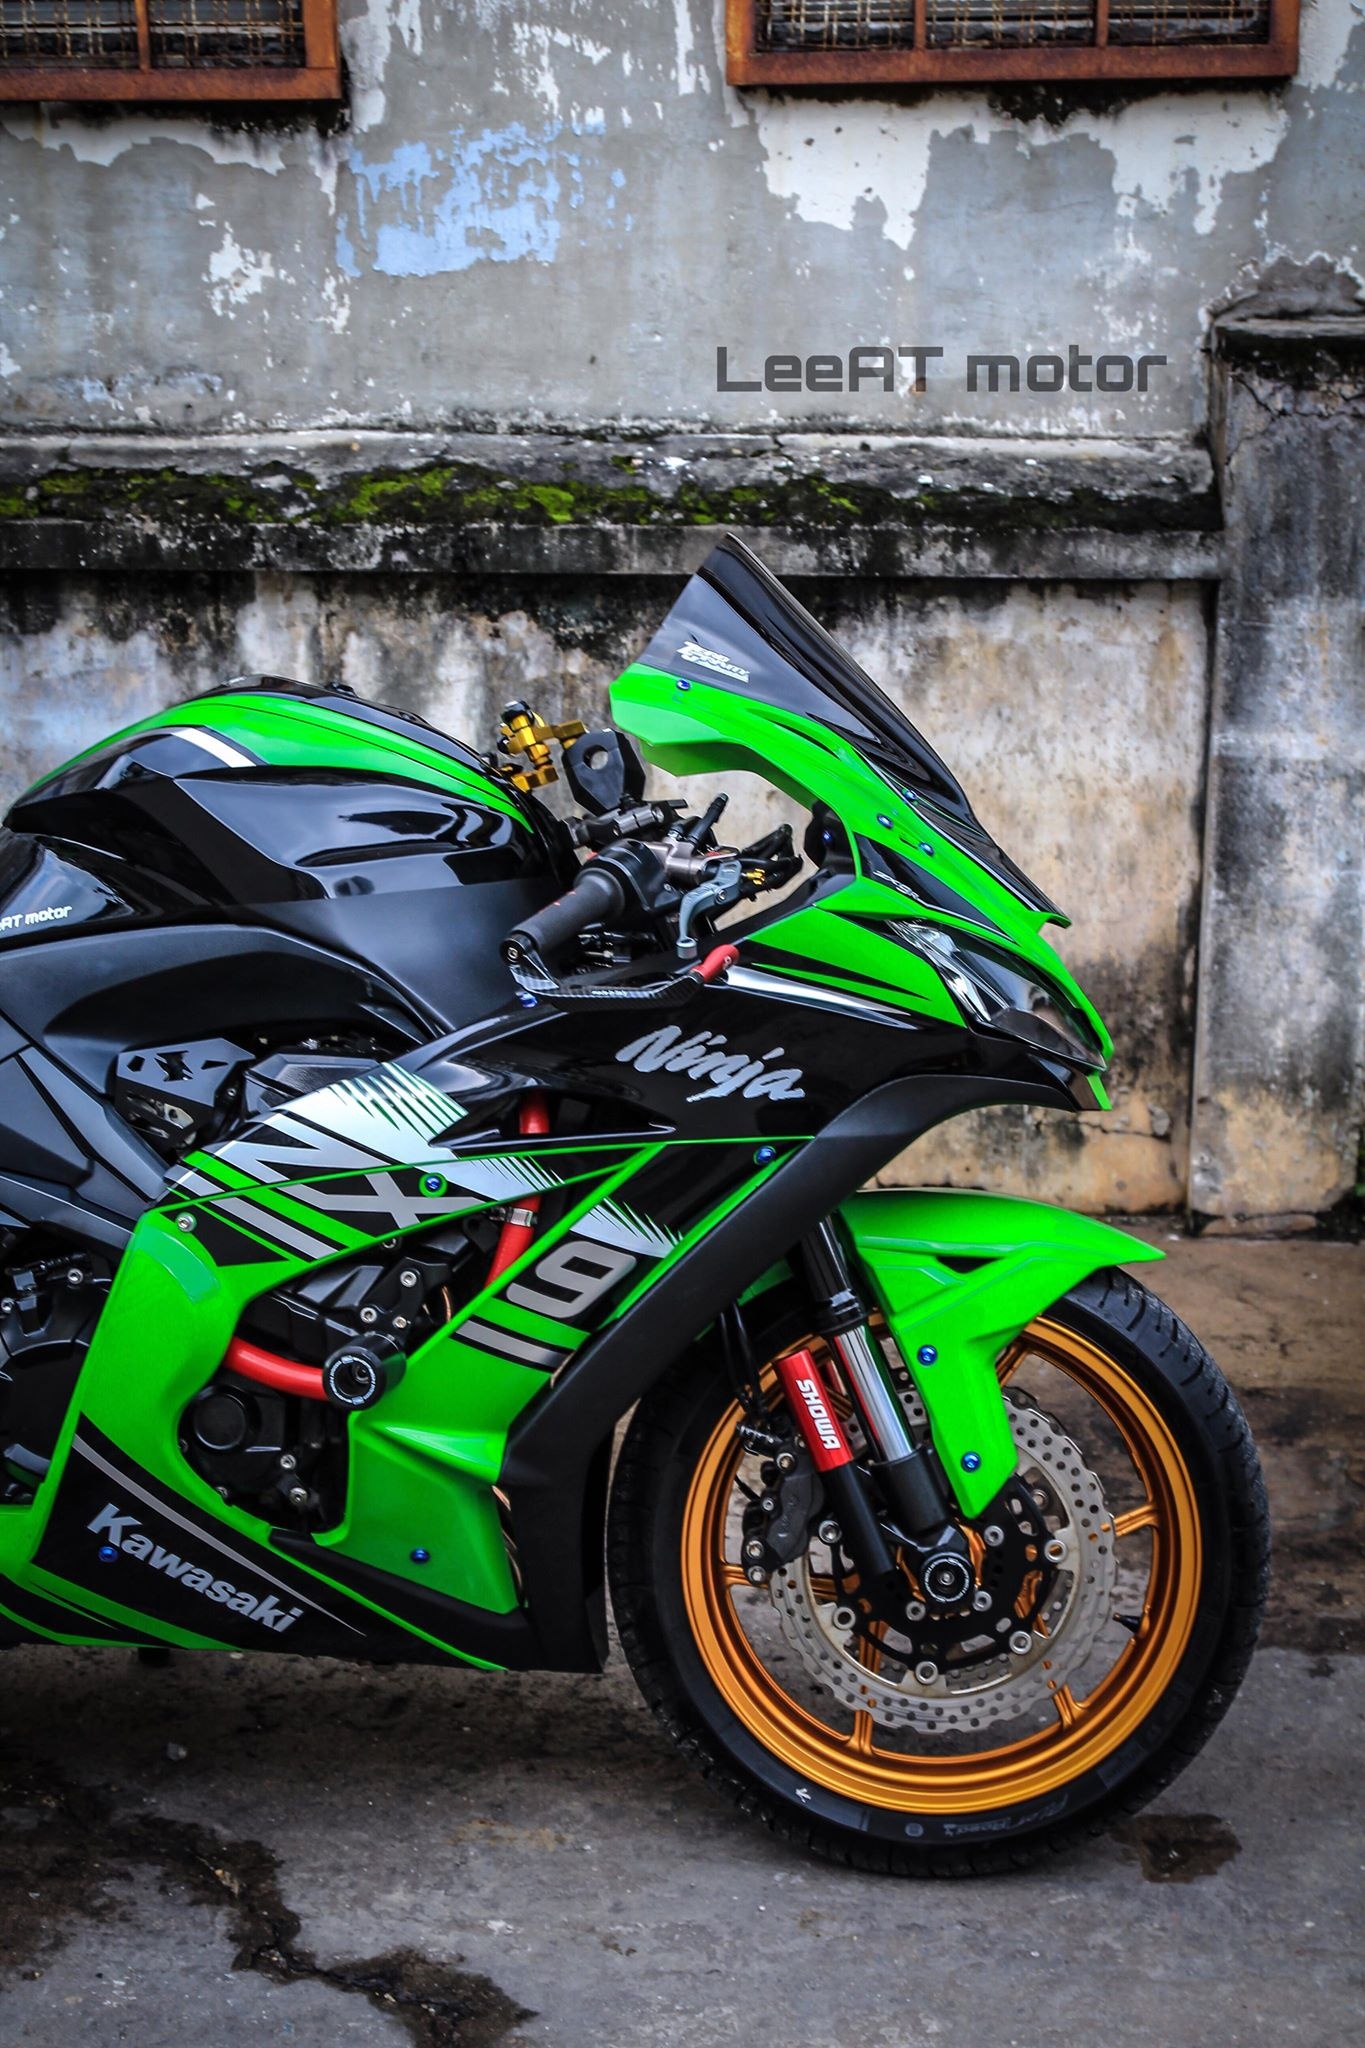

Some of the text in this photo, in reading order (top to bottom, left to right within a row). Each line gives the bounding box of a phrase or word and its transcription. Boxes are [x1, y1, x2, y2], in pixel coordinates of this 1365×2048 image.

[0, 906, 73, 931] AT motor
[615, 1025, 806, 1103] Ninja
[795, 1379, 841, 1450] SHOWA
[87, 1502, 304, 1633] Kawasaki
